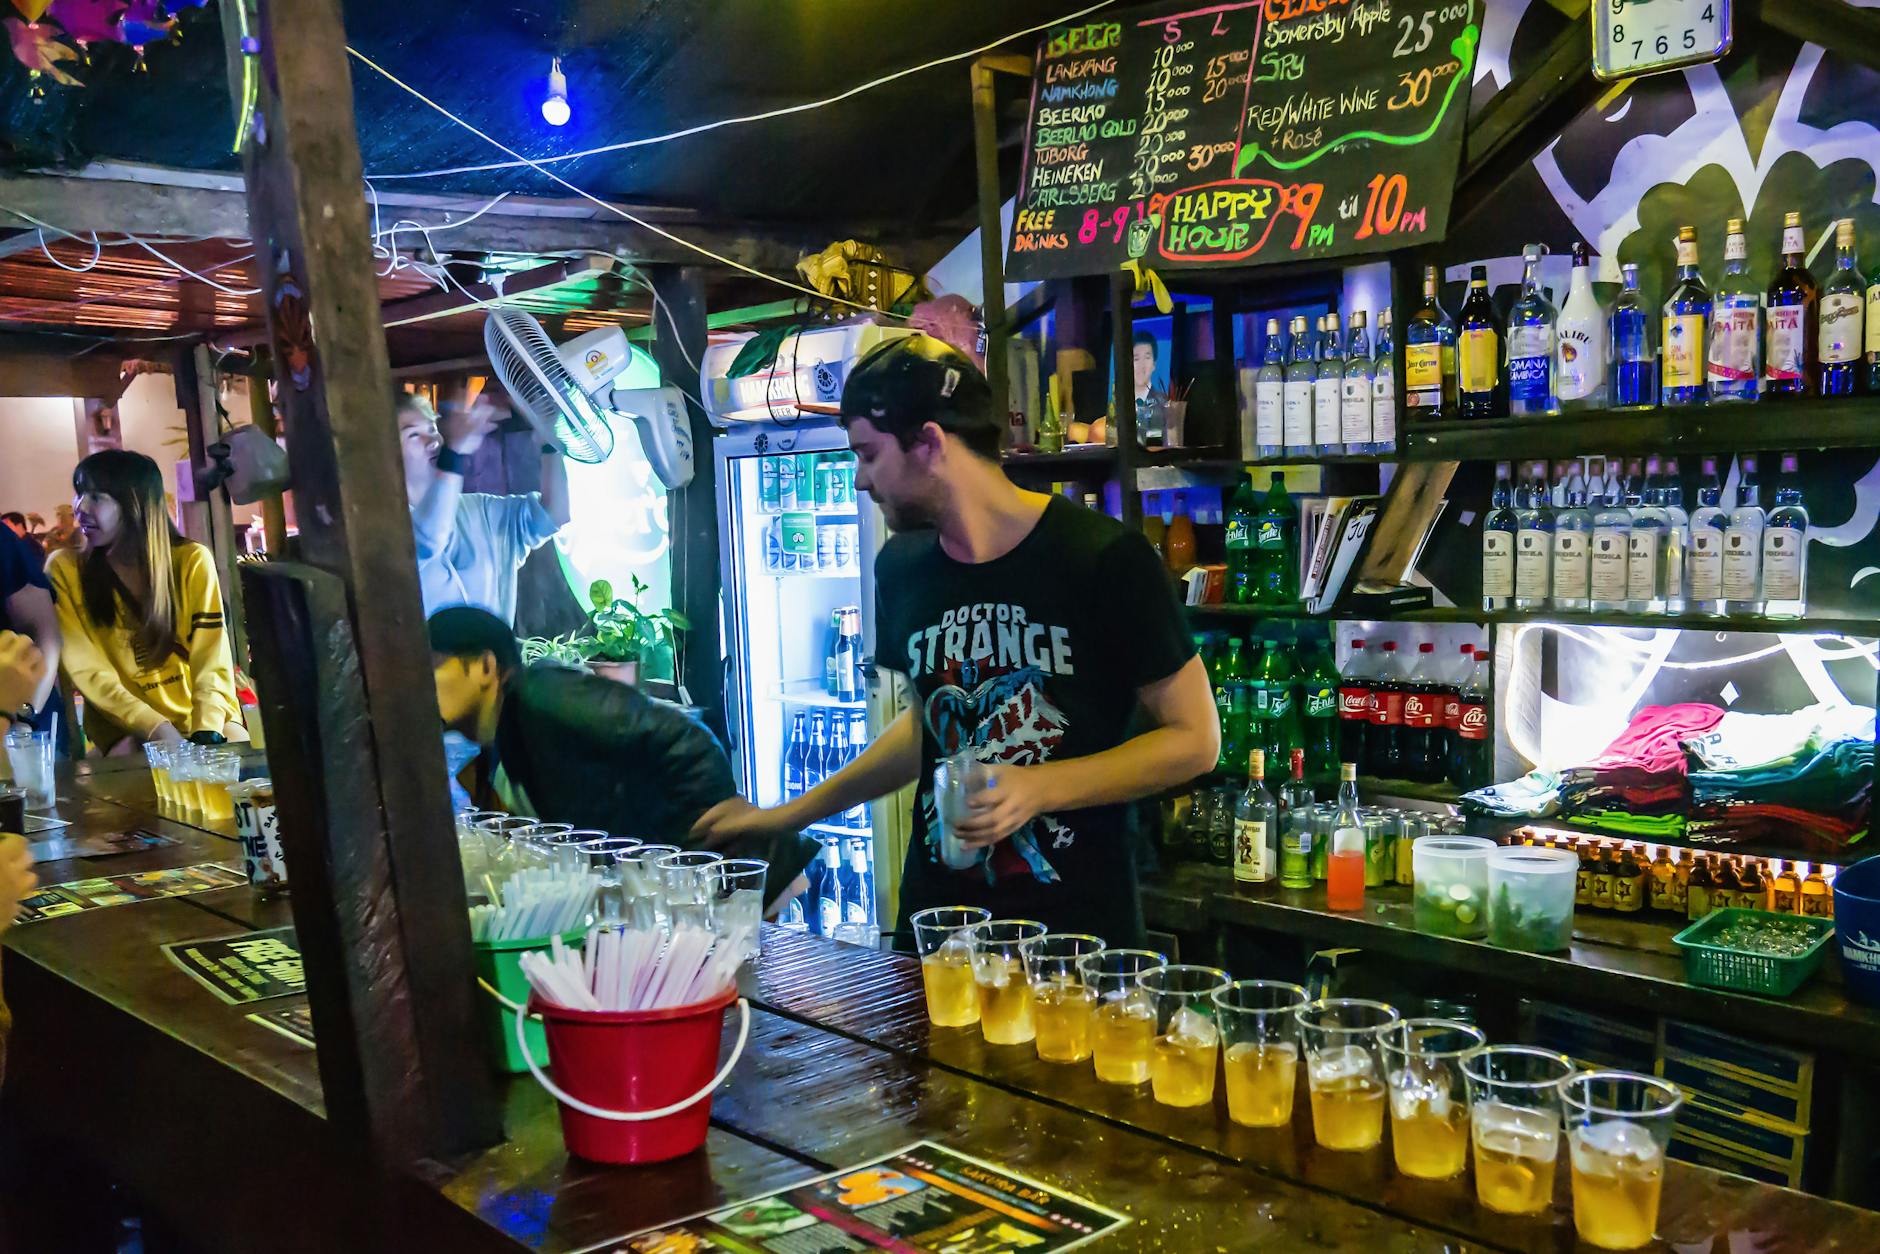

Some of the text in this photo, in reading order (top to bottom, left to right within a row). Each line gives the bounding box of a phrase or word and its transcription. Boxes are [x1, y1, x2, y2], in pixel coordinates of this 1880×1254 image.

[1612, 0, 1624, 14] 9
[1701, 4, 1714, 23] 4
[1045, 12, 1230, 59] BEER S L
[1264, 12, 1346, 49] Somersby
[1350, 4, 1392, 36] Apple
[1613, 24, 1625, 43] 8
[1683, 29, 1695, 49] 5
[1632, 40, 1643, 59] 7
[1656, 36, 1668, 55] 6
[1046, 56, 1118, 84] LANEXANG
[1254, 52, 1305, 82] SPY
[1041, 78, 1119, 103] NAMKHONG
[1036, 104, 1106, 126] BEERLAO
[1247, 86, 1380, 135] RED/WHITE WINE
[1035, 122, 1097, 147] BEERLAO
[1035, 142, 1089, 165] TUBORG
[1031, 158, 1104, 188] HEINEKEN
[1027, 182, 1118, 209] CARLSBERG
[1172, 188, 1272, 223] HAPPY
[1016, 209, 1055, 232] FREE
[1308, 223, 1334, 247] PM
[1338, 192, 1359, 220] til
[1354, 173, 1408, 240] 10
[1400, 207, 1427, 233] PM
[1168, 222, 1249, 252] HOUR
[1510, 359, 1548, 372] OMANA
[941, 603, 1028, 630] DOCTOR
[907, 617, 1075, 680] STRANGE
